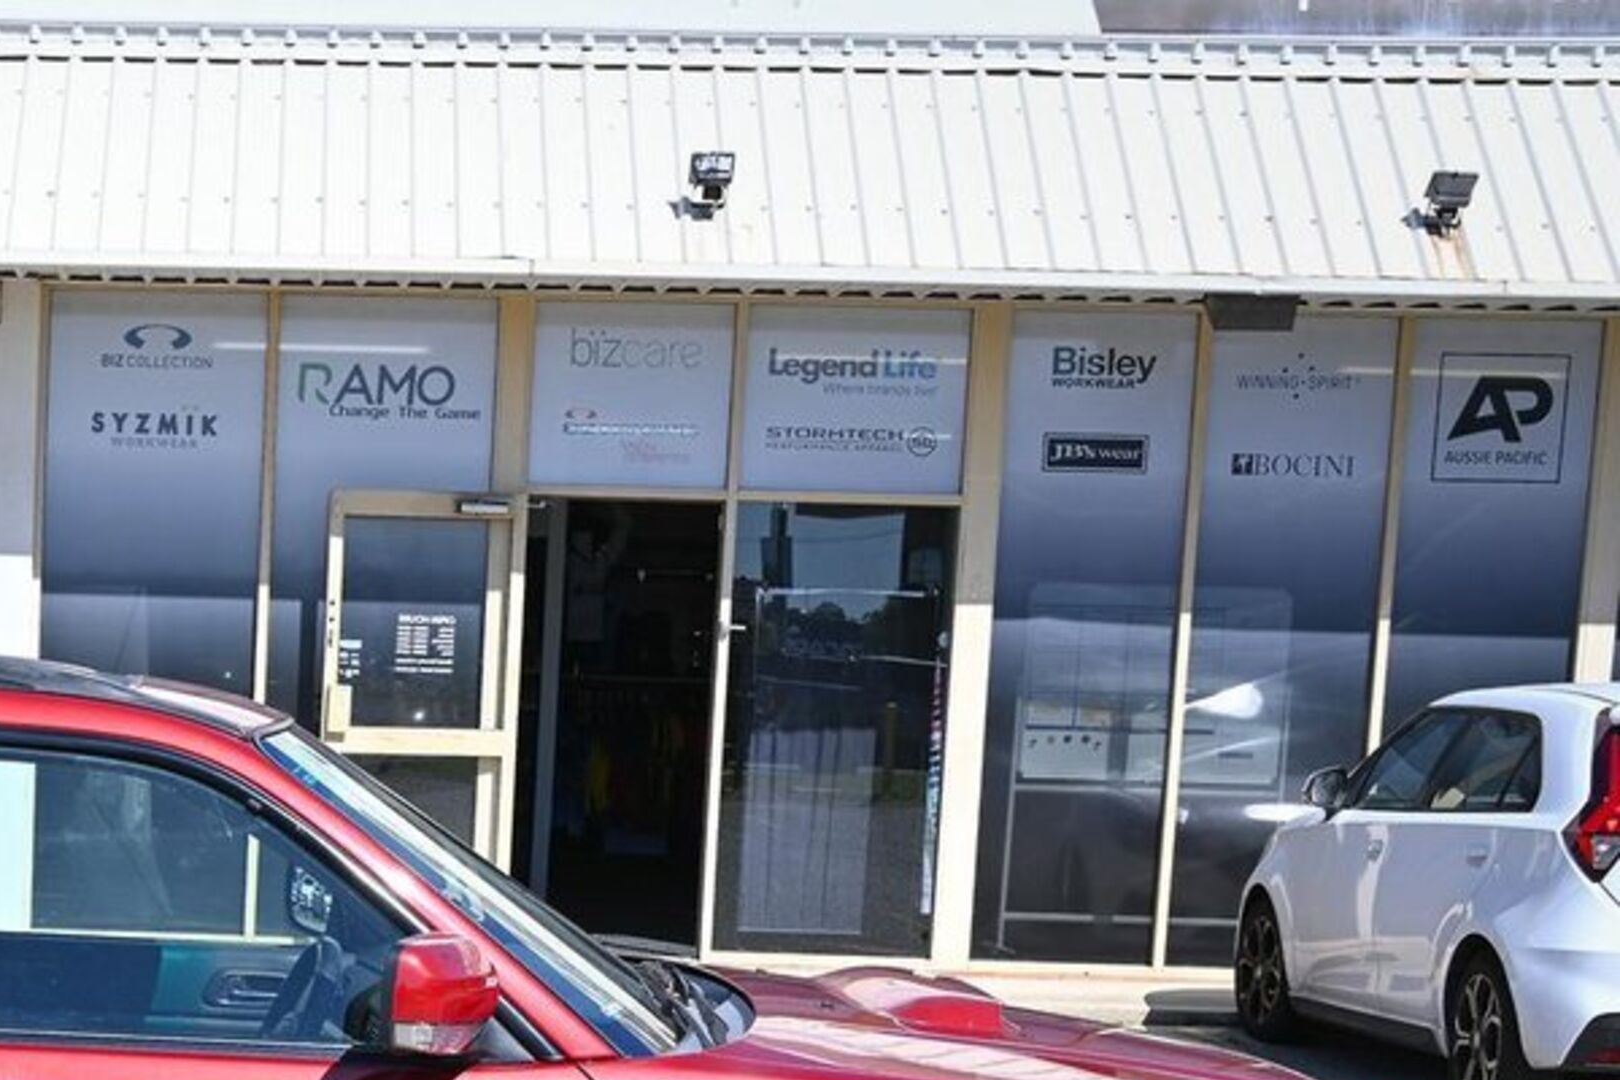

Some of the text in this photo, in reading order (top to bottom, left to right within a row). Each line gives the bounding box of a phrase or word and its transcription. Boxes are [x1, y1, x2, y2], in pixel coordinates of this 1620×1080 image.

[570, 327, 704, 369] bizcare
[126, 355, 215, 369] COLLECTION
[767, 347, 937, 384] Legend Life
[1052, 346, 1157, 385] Bisley
[298, 363, 455, 406] RAMO
[1051, 378, 1135, 389] WORKWEAR
[329, 403, 481, 420] Change The Game
[1447, 375, 1554, 443] AP
[766, 426, 906, 441] STORMTECH
[1254, 452, 1355, 478] BOCINI
[1444, 449, 1548, 466] AUSSIE PACIFIC
